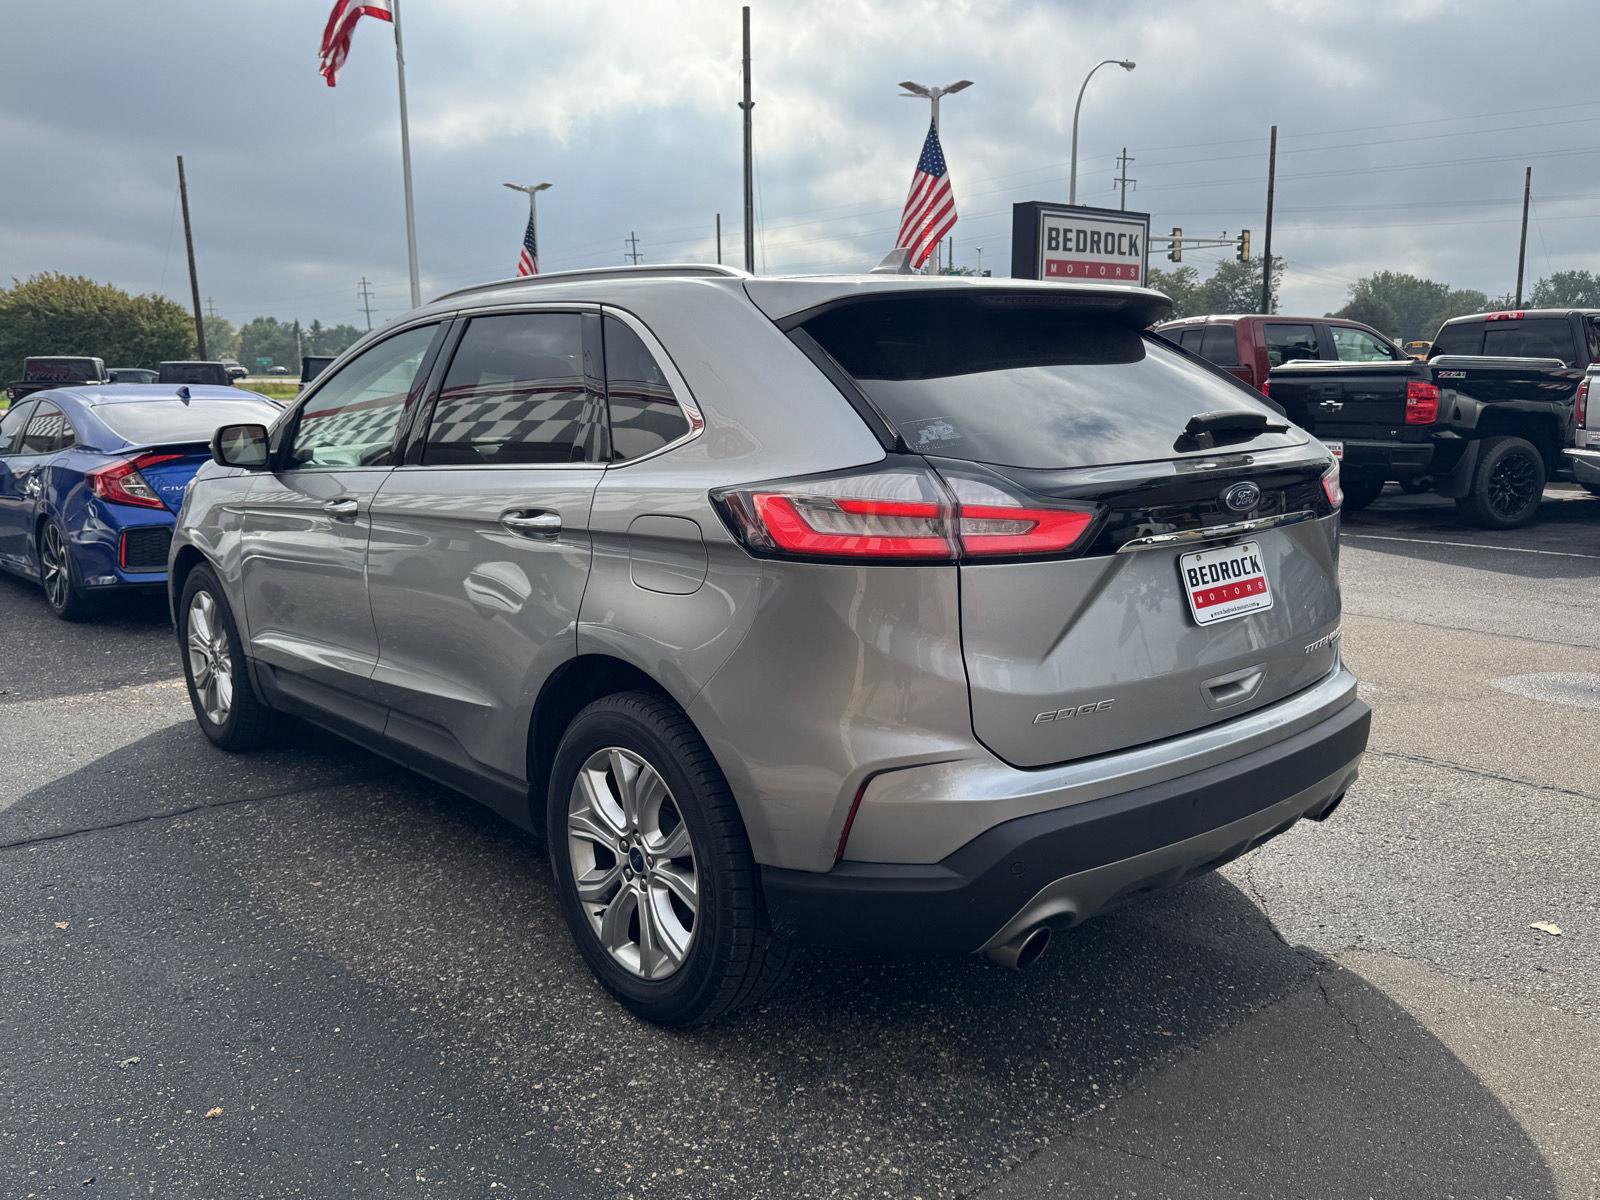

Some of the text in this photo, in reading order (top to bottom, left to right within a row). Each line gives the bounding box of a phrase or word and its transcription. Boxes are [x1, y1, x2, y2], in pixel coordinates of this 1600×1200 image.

[1047, 226, 1140, 257] BEDROCK
[1050, 263, 1136, 278] MOTORS
[1186, 554, 1262, 588] BEDROCK
[1197, 581, 1263, 604] MOTORS
[1032, 699, 1116, 725] EDGE
